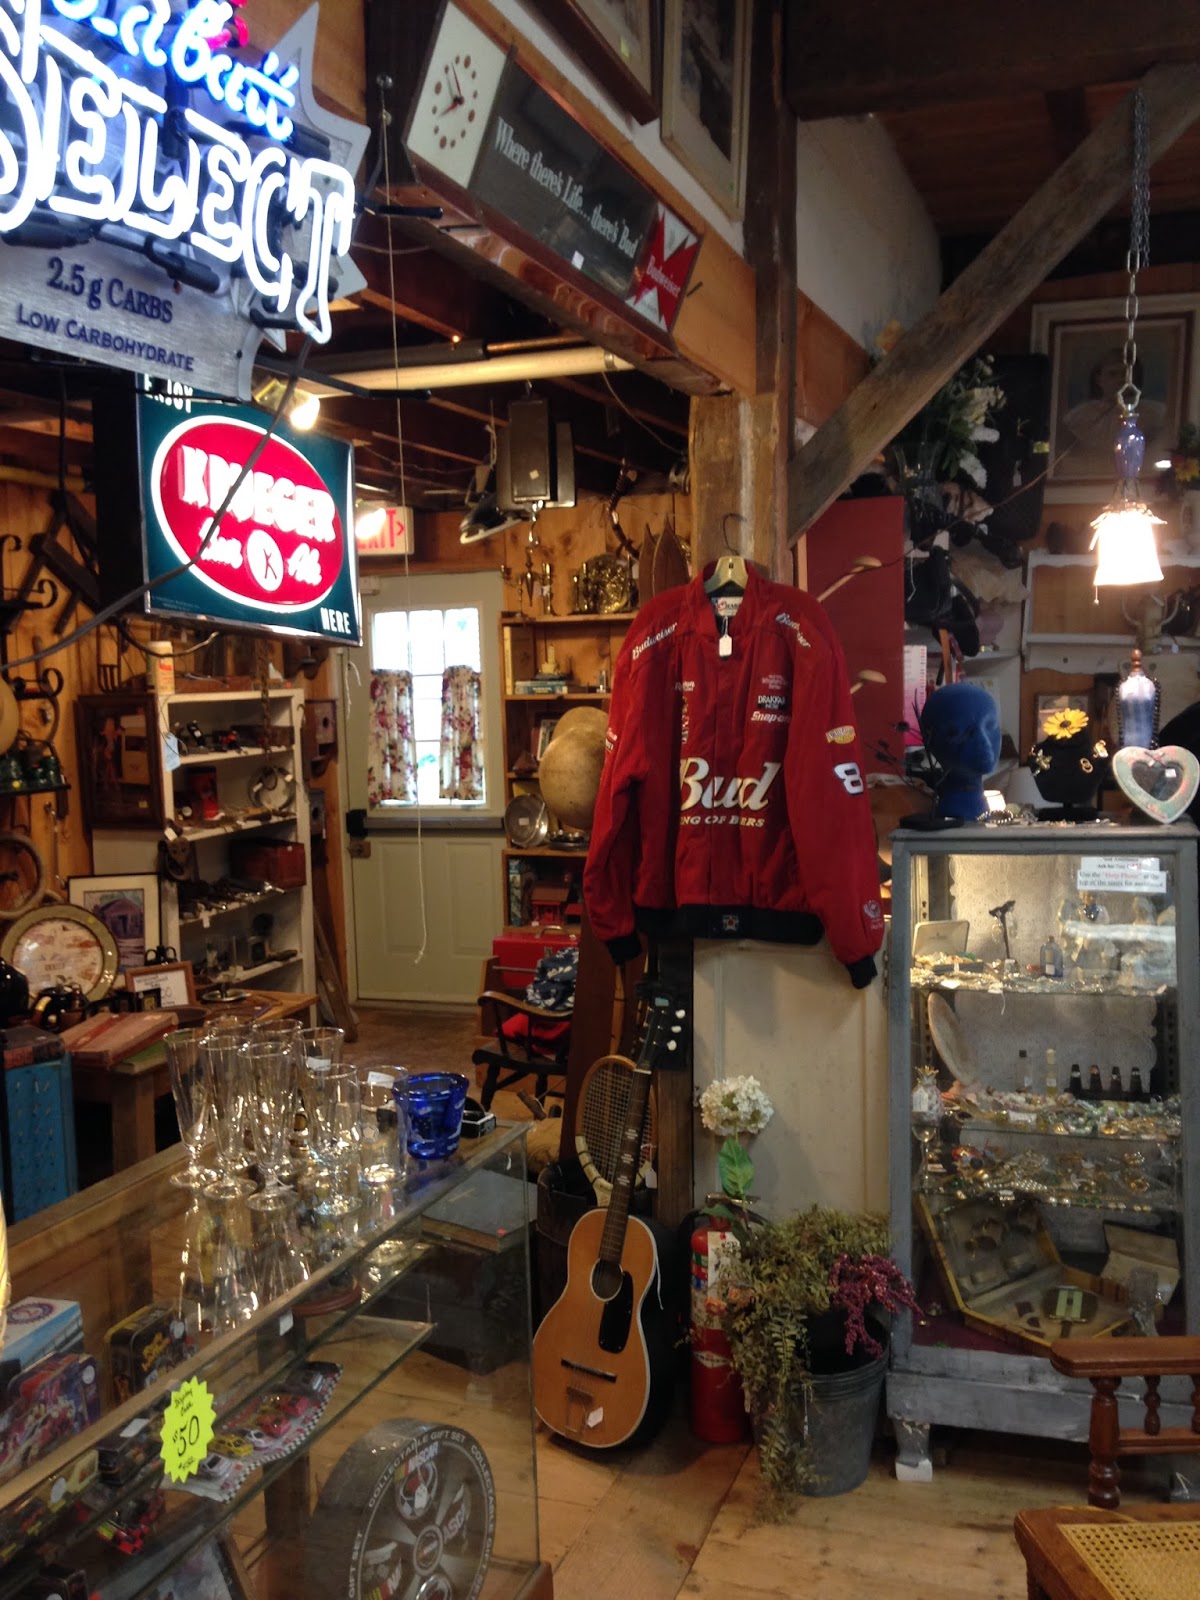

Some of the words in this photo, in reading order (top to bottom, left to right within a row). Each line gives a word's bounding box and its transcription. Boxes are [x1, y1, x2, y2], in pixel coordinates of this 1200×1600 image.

[495, 116, 530, 170] Where
[529, 151, 564, 198] there's
[590, 203, 619, 244] there's
[107, 278, 174, 325] CARBS
[16, 303, 61, 335] LOW
[65, 319, 196, 372] CARBOHYDRATE
[144, 373, 194, 414] EJOY
[320, 607, 352, 635] HERE
[632, 621, 677, 660] Budweiser
[775, 612, 811, 648] Budiser
[680, 756, 782, 812] Bud
[834, 762, 864, 795] 8
[430, 1428, 450, 1442] GIFT
[450, 1428, 467, 1444] SET
